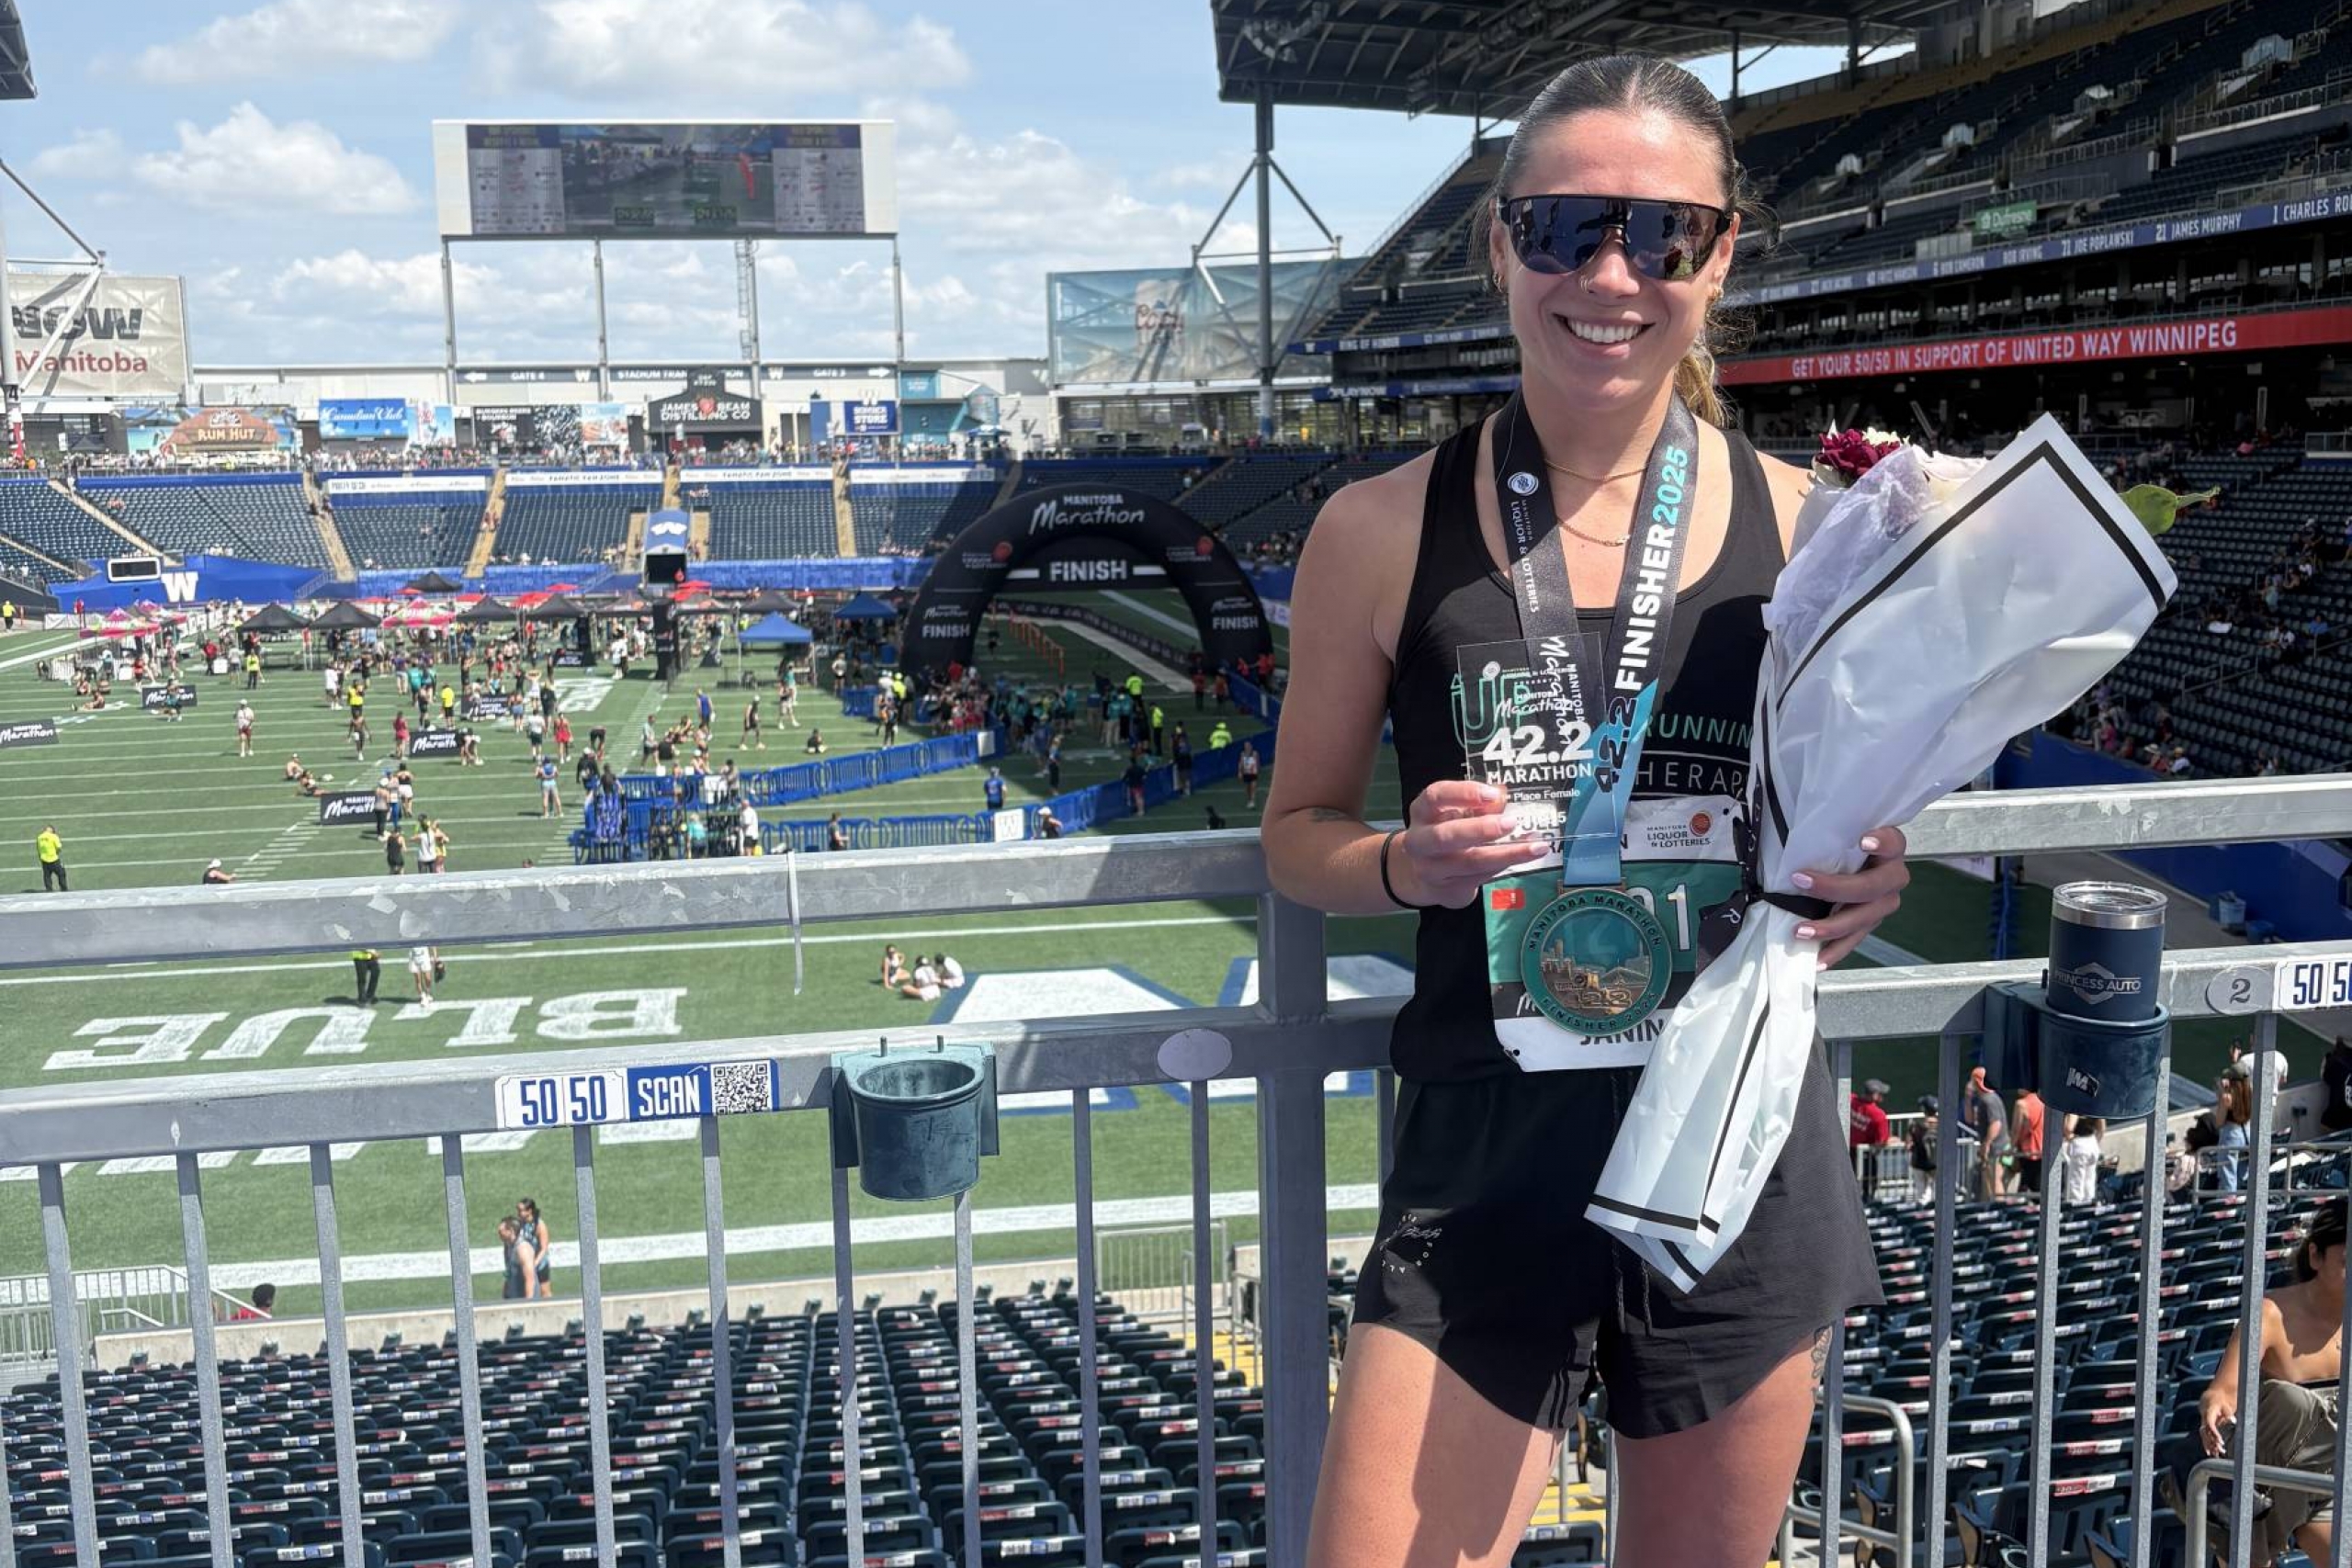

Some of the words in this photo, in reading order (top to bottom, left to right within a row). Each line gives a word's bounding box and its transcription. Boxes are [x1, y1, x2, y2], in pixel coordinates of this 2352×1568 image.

[2273, 206, 2278, 224] 1
[2283, 198, 2329, 221] CHARLES
[2155, 224, 2166, 242] 21
[2172, 220, 2199, 240] JAMES
[2201, 212, 2242, 235] MURPHY
[2074, 237, 2087, 254] JOE
[15, 350, 148, 372] Manitoba
[1792, 358, 1815, 378] GET
[1817, 354, 1851, 375] YOUR
[1855, 351, 1890, 375] 50/50
[1895, 347, 1909, 368] IN
[1915, 343, 1980, 368] SUPPORT
[1984, 341, 2006, 364] OF
[2012, 335, 2075, 362] UNITED
[2082, 332, 2123, 357] WAY
[2129, 321, 2237, 354] WINNIPEG
[617, 369, 661, 379] STADIUM
[376, 407, 403, 421] Club
[661, 402, 698, 412] JAMES
[718, 402, 751, 412] BEAM
[198, 429, 226, 441] RUM
[230, 429, 255, 440] HUT
[1063, 494, 1124, 505] MANITOBA
[1030, 502, 1145, 535] Marathon
[1510, 501, 1526, 545] LIQUOR
[1521, 557, 1540, 613] LOTTERIES
[1049, 560, 1127, 582] FINISH
[161, 571, 198, 602] W
[922, 625, 970, 638] FINISH
[1213, 616, 1259, 630] FINISH
[0, 728, 53, 744] Marathon
[1482, 721, 1594, 765] 42.2
[1646, 715, 1753, 750] UNNIN
[1487, 762, 1592, 785] MARATHON
[1635, 761, 1744, 795] HERAP
[1513, 791, 1541, 802] Place
[1544, 788, 1580, 799] Female
[1647, 830, 1688, 840] LIQUOR
[1660, 838, 1711, 848] LOTTERIES
[1529, 897, 1586, 950] MANITOBA
[1594, 896, 1662, 946] MARATHON
[2053, 968, 2105, 991] PRINCESS
[2107, 978, 2142, 993] AUTO
[2230, 978, 2251, 1004] 2
[2292, 964, 2323, 1005] 50
[2332, 962, 2352, 1003] 5
[1541, 998, 1617, 1030] FINISHER
[41, 987, 687, 1070] BLUE
[519, 1080, 558, 1125] 50
[570, 1077, 607, 1122] 50
[639, 1072, 705, 1116] SCAN
